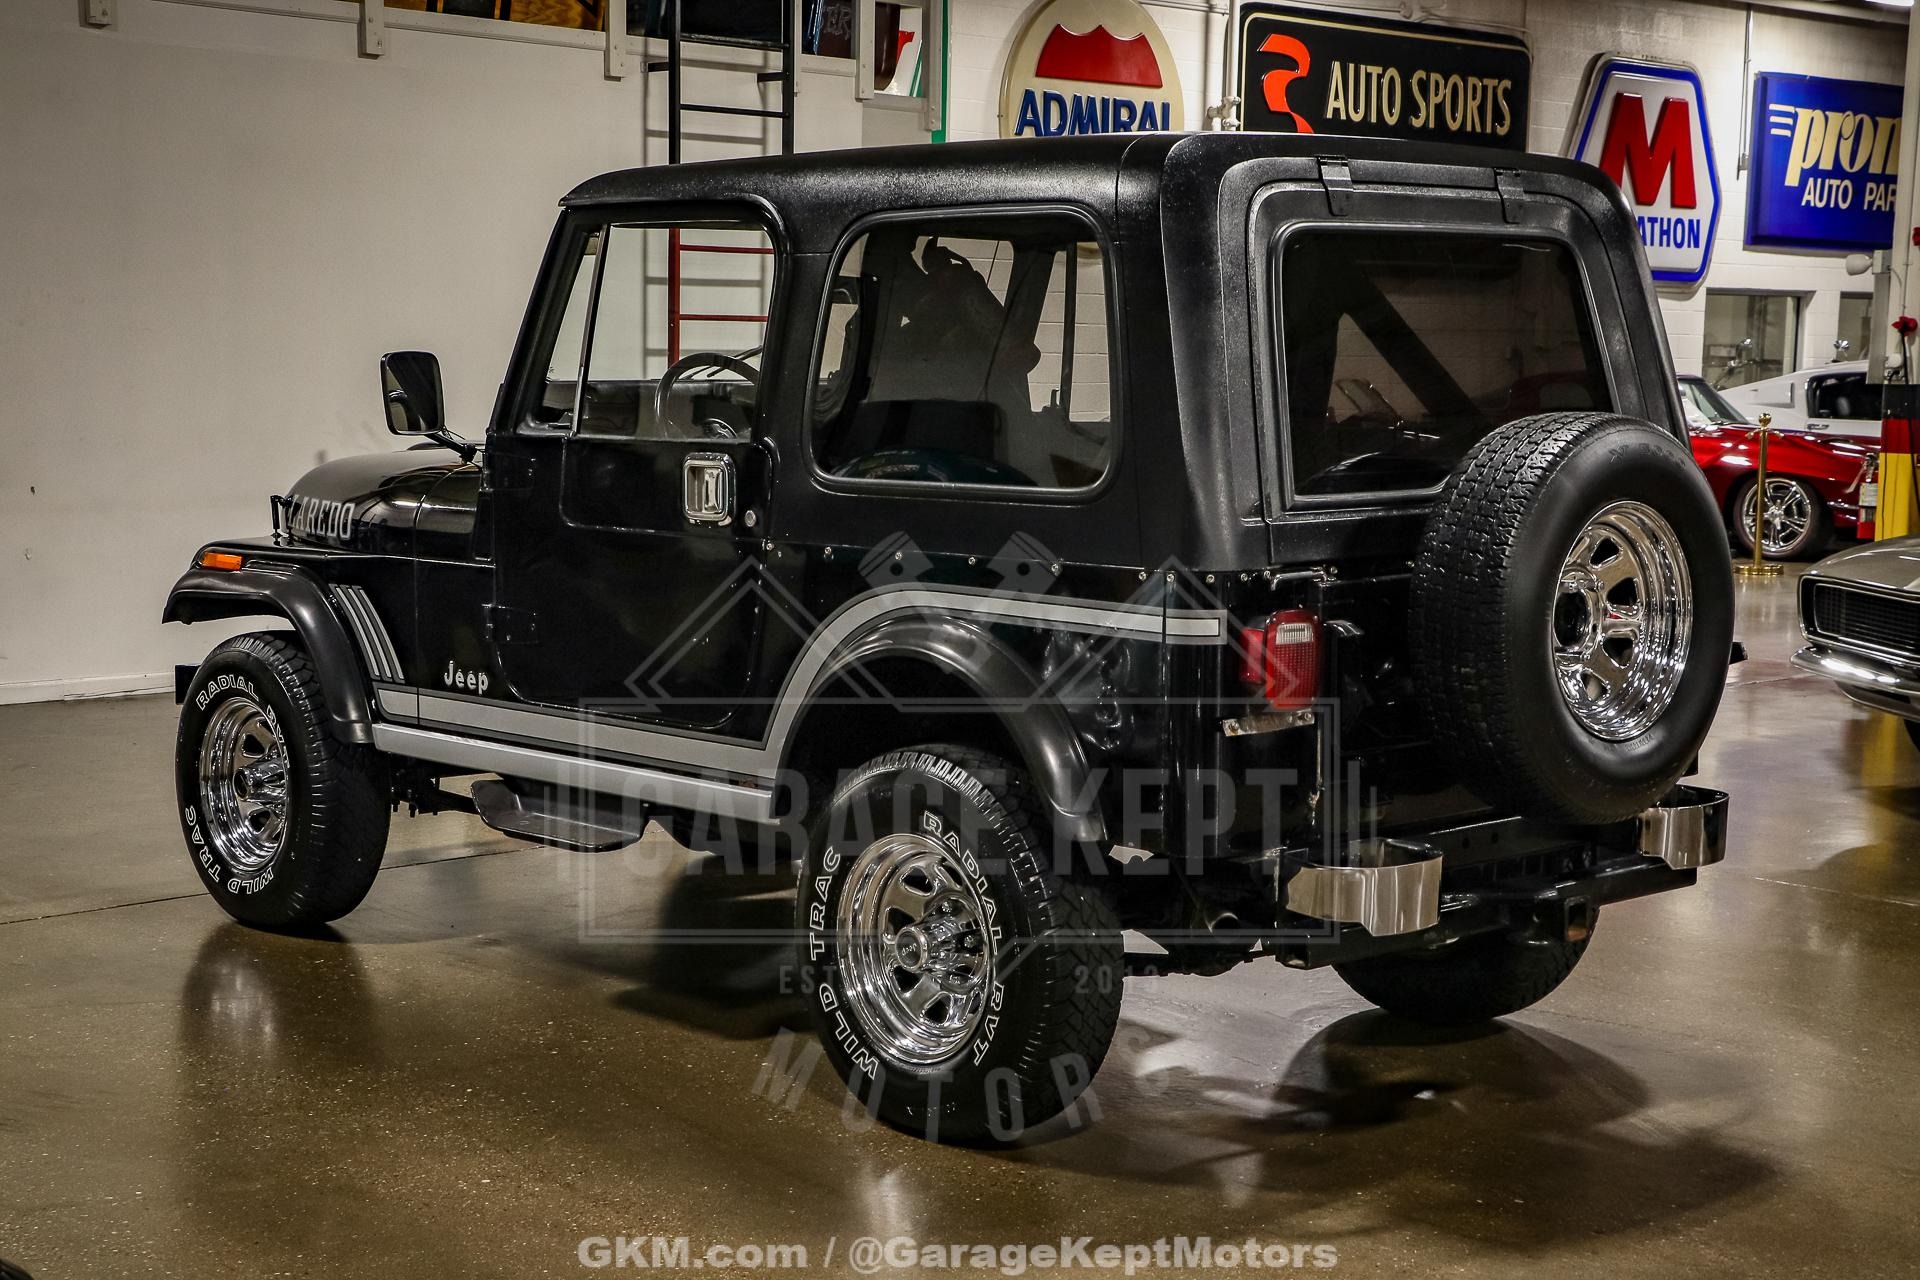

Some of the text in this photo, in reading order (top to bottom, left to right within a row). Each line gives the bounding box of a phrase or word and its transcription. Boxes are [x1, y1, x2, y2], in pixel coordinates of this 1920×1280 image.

[1326, 60, 1512, 136] AUTO SPORTS
[1784, 108, 1902, 187] pron
[1637, 215, 1700, 249] ATHON
[1801, 177, 1898, 212] AUTO PAR
[195, 674, 260, 711] RADIAL
[444, 660, 489, 695] Jeep
[185, 804, 274, 894] WILD TRAC
[809, 846, 879, 1081] WILD TRAC
[923, 810, 1006, 1066] RADIAL RVT
